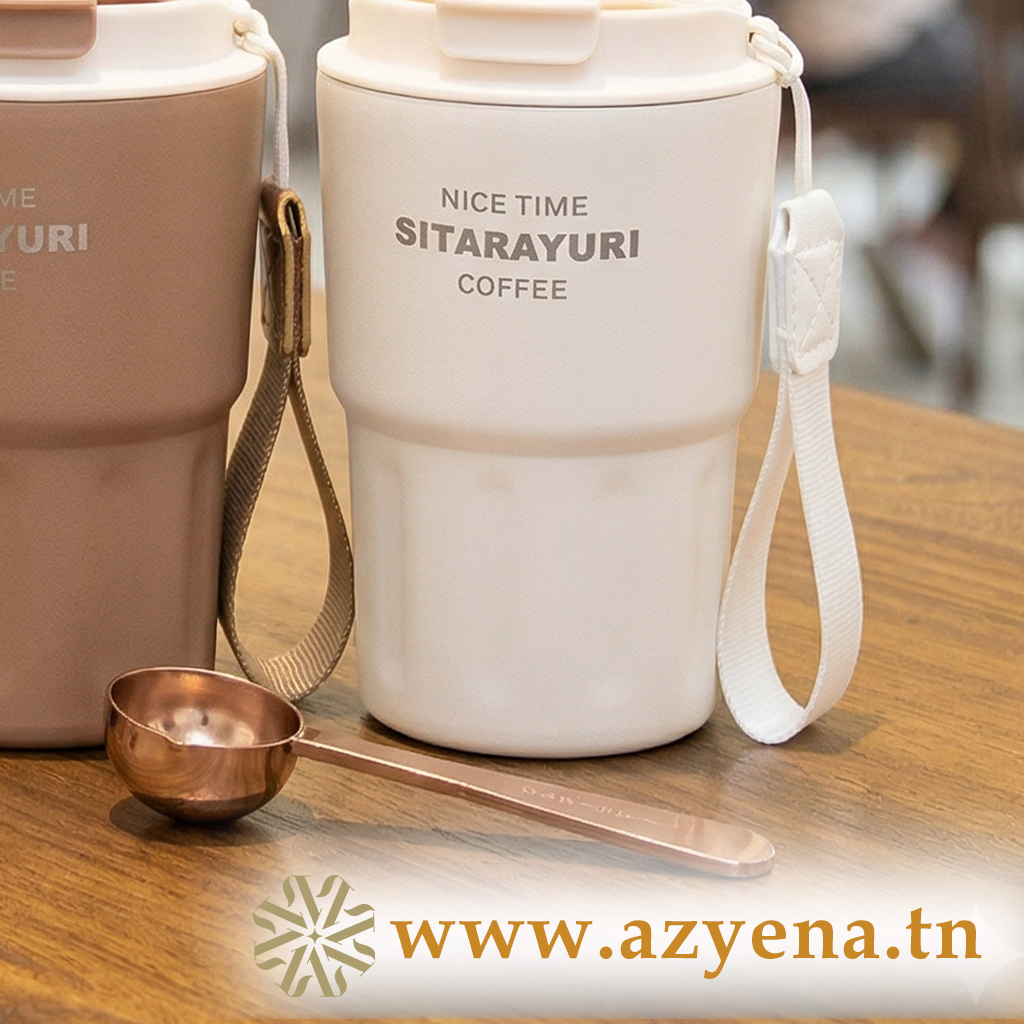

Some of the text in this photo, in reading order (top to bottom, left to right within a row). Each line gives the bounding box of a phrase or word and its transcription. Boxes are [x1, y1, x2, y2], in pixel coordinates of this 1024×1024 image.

[441, 187, 588, 217] NICE TIME
[395, 217, 639, 262] SITARAYURI
[458, 273, 567, 300] COFFEE
